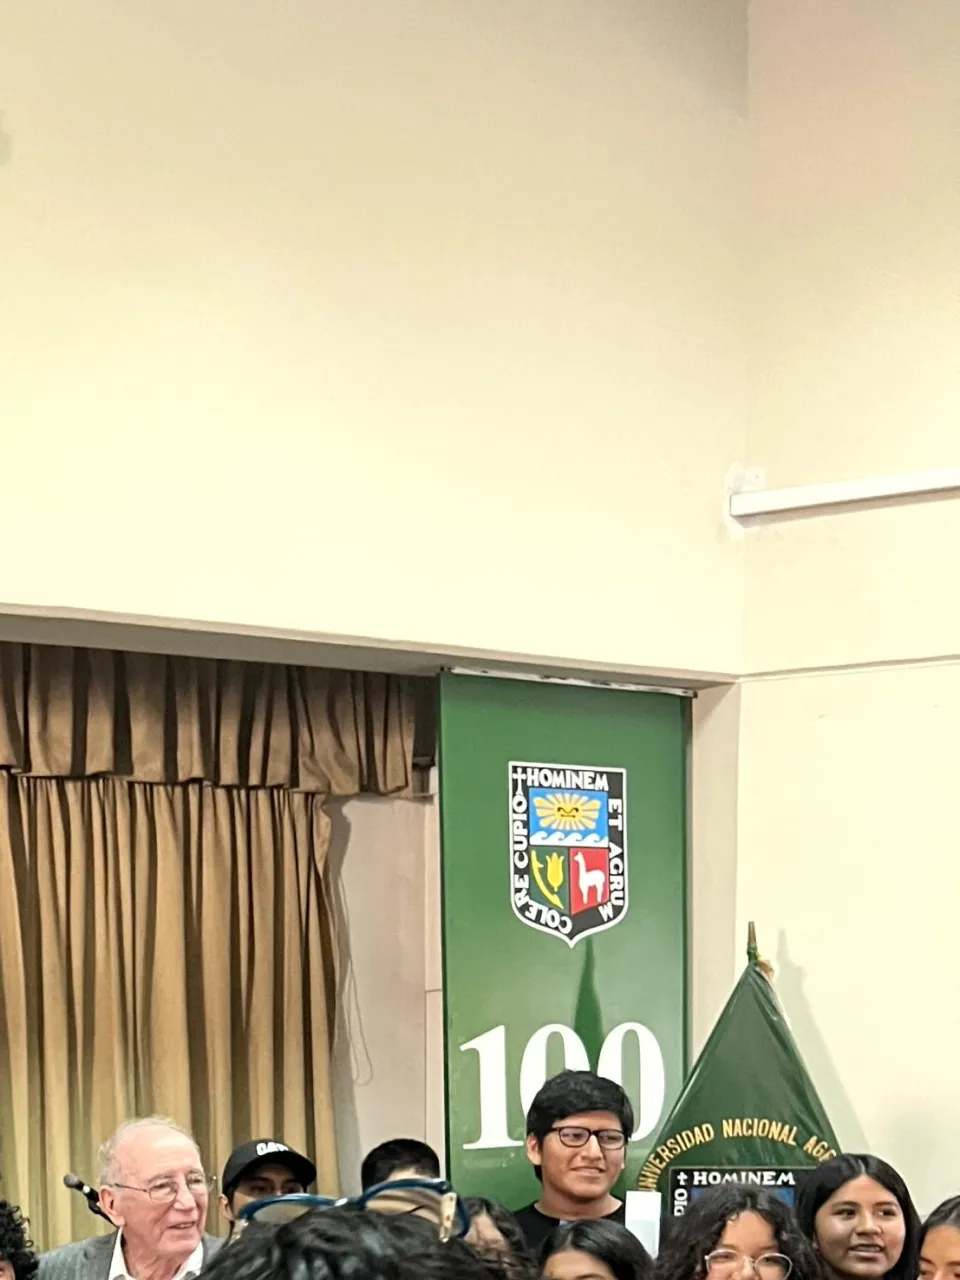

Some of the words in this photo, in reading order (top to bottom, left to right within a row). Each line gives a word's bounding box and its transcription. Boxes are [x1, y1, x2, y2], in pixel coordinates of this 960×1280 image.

[526, 767, 609, 791] HOMINEM
[512, 795, 529, 869] CUPIO
[608, 798, 622, 831] ET
[513, 874, 573, 935] COLERE
[598, 841, 624, 922] AGRUM
[460, 1021, 665, 1150] 100
[638, 1123, 715, 1192] NIVERSIDAD
[722, 1118, 798, 1146] NACIONAL
[803, 1135, 837, 1162] AGR
[692, 1171, 796, 1186] HOMINEM
[673, 1188, 689, 1217] PIO
